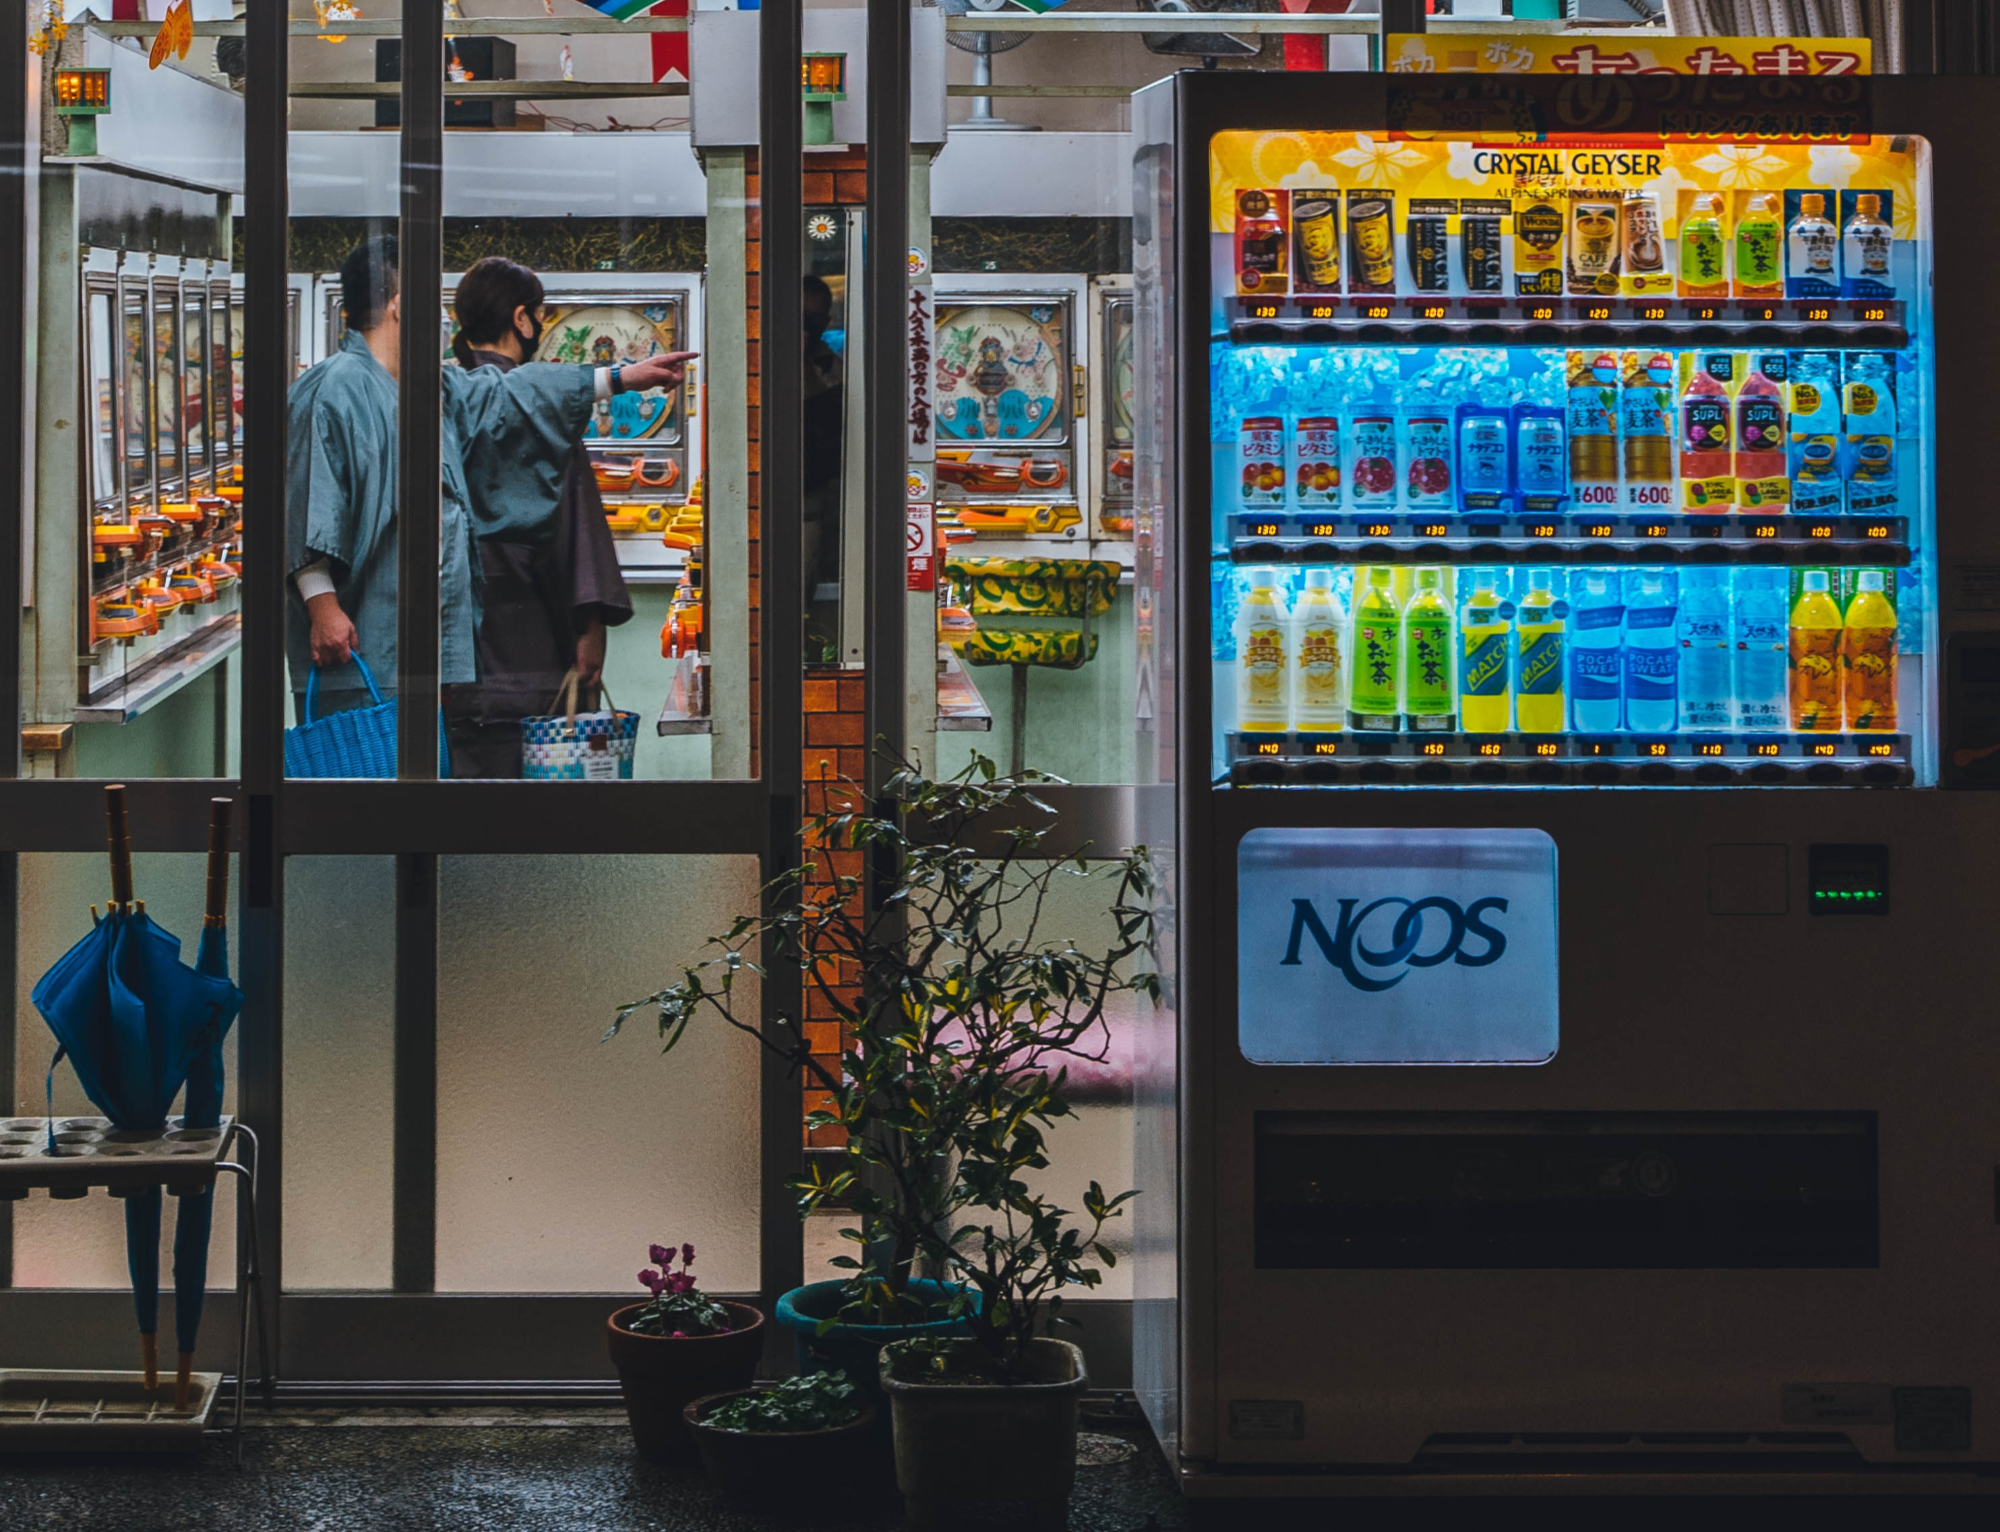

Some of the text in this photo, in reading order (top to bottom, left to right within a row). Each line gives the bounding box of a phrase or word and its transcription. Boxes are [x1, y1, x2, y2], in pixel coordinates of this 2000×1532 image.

[1484, 40, 1535, 70] ポカ
[1657, 112, 1858, 142] ドリンクあります
[1474, 152, 1662, 176] CRYSTAL GEYSER
[1494, 188, 1645, 200] ALPINE SPRING WATER
[1434, 223, 1448, 287] BLACK
[1485, 223, 1501, 287] BLACK
[1256, 306, 1276, 318] 130
[1312, 306, 1332, 318] 100
[1368, 307, 1389, 318] 100
[1424, 307, 1445, 319] 100
[1533, 308, 1553, 319] 100
[1589, 308, 1609, 319] 120
[1645, 308, 1665, 319] 130
[1809, 309, 1828, 320] 130
[1865, 309, 1885, 320] 130
[1710, 363, 1731, 374] 555
[1764, 363, 1785, 374] 555
[1571, 408, 1600, 429] 麦茶
[1626, 408, 1655, 429] 麦茶
[1363, 446, 1388, 456] トマト
[1417, 447, 1443, 457] トマト
[1582, 486, 1615, 504] 600
[1638, 487, 1670, 504] 600
[1257, 524, 1277, 536] 130
[1313, 524, 1333, 536] 130
[1369, 525, 1389, 536] 130
[1425, 525, 1446, 536] 130
[1535, 526, 1554, 537] 130
[1591, 526, 1611, 537] 130
[1647, 526, 1666, 537] 130
[1756, 526, 1775, 537] 130
[1811, 526, 1831, 538] 100
[1867, 526, 1888, 538] 100
[1688, 622, 1724, 636] 天然水
[1744, 625, 1781, 639] 天然水
[1367, 640, 1392, 686] お茶
[1417, 640, 1444, 686] お茶
[1467, 637, 1508, 685] MATCH
[1521, 636, 1562, 684] MATCH
[1577, 654, 1619, 664] POCAR
[1629, 664, 1672, 674] SWEAT
[1259, 743, 1279, 754] 140
[1315, 743, 1336, 754] 140
[1424, 743, 1444, 755] 150
[1480, 744, 1501, 755] 160
[1537, 743, 1557, 755] 160
[1650, 744, 1666, 756] 50
[1702, 744, 1722, 755] 110
[1758, 744, 1778, 755] 110
[1814, 744, 1835, 756] 140
[1869, 744, 1891, 756] 140
[1279, 896, 1510, 992] NOOS
